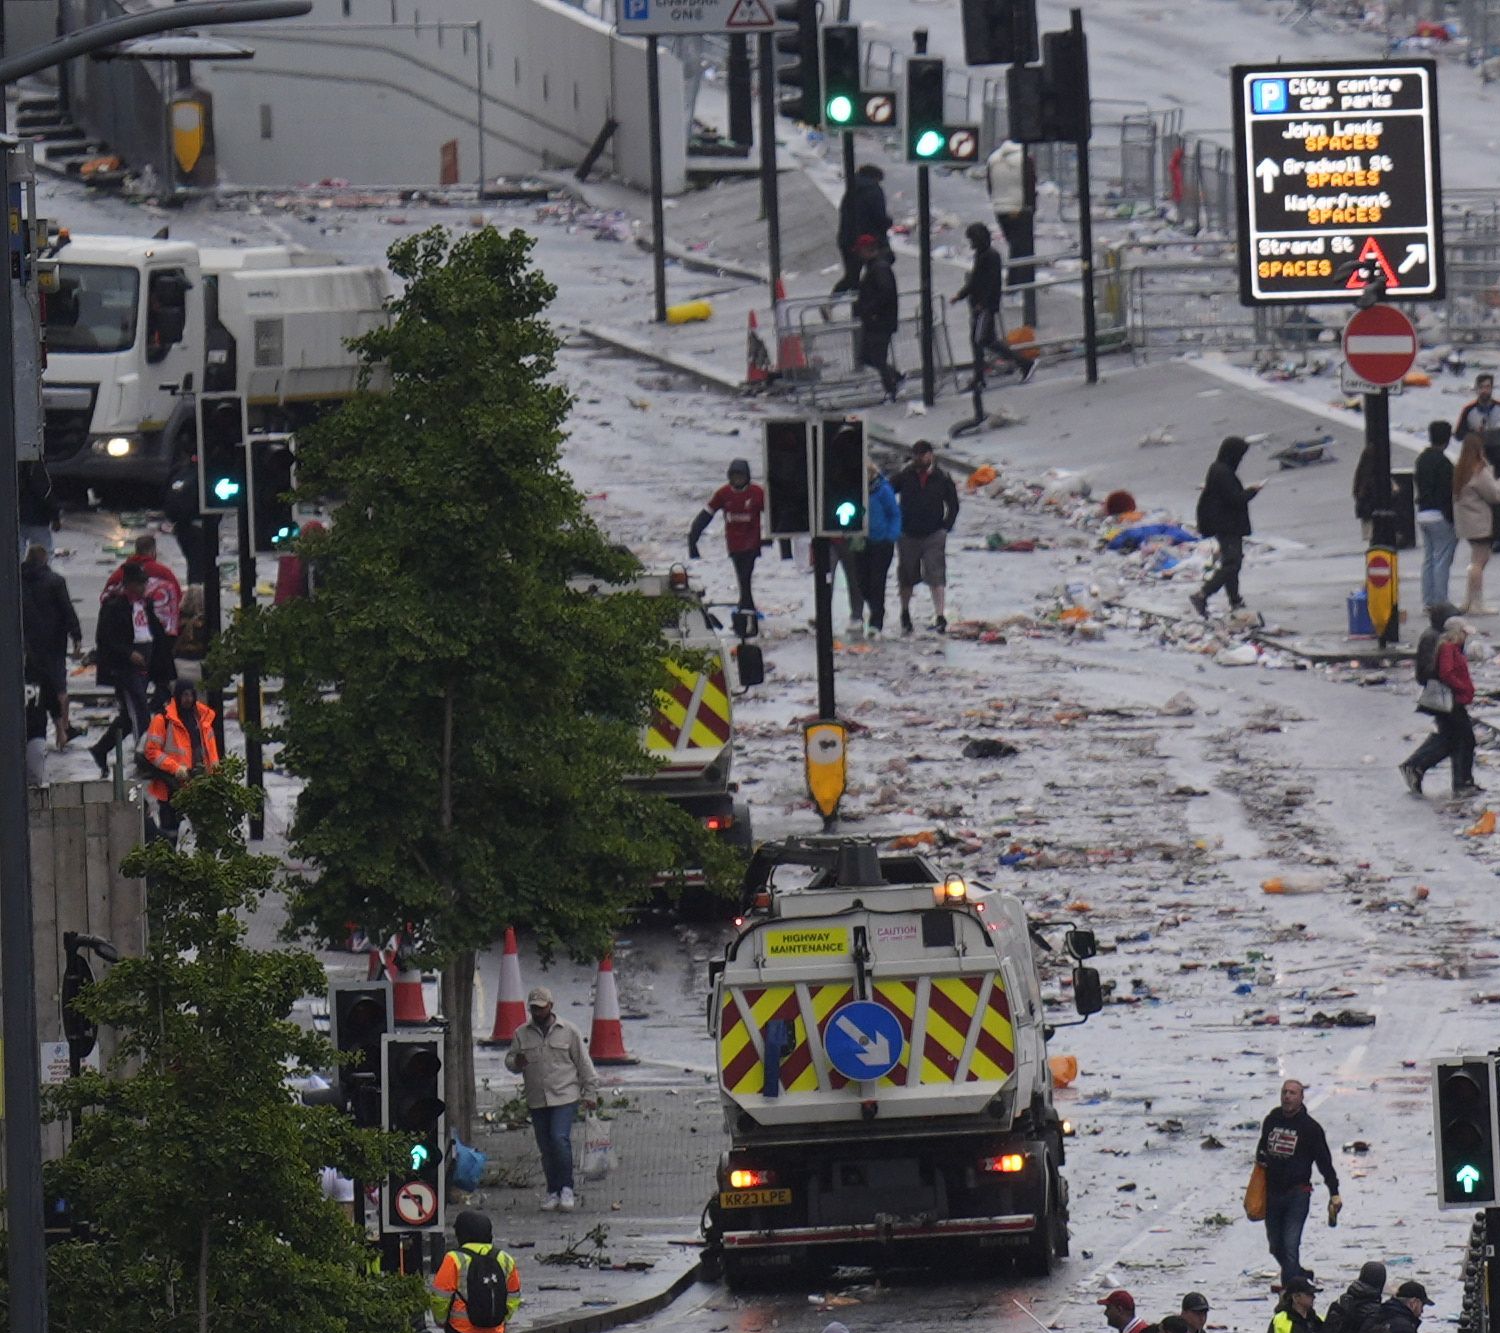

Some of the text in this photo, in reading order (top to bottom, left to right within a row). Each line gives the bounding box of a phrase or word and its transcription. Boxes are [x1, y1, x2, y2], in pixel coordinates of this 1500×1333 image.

[1289, 76, 1403, 96] City centre
[1300, 93, 1393, 110] car parks
[1282, 120, 1383, 139] John Lewis
[1305, 135, 1379, 152] SPACES
[1283, 155, 1393, 176] Gradwell St
[1306, 170, 1381, 188] SPACES
[1285, 192, 1391, 211] Waterfront
[1308, 207, 1382, 224] SPACES
[1259, 236, 1354, 256] Strand St
[1259, 260, 1332, 278] SPACES
[783, 932, 830, 943] HIGHWAY
[771, 943, 844, 956] MAINTENANCE
[725, 1193, 760, 1207] KR23
